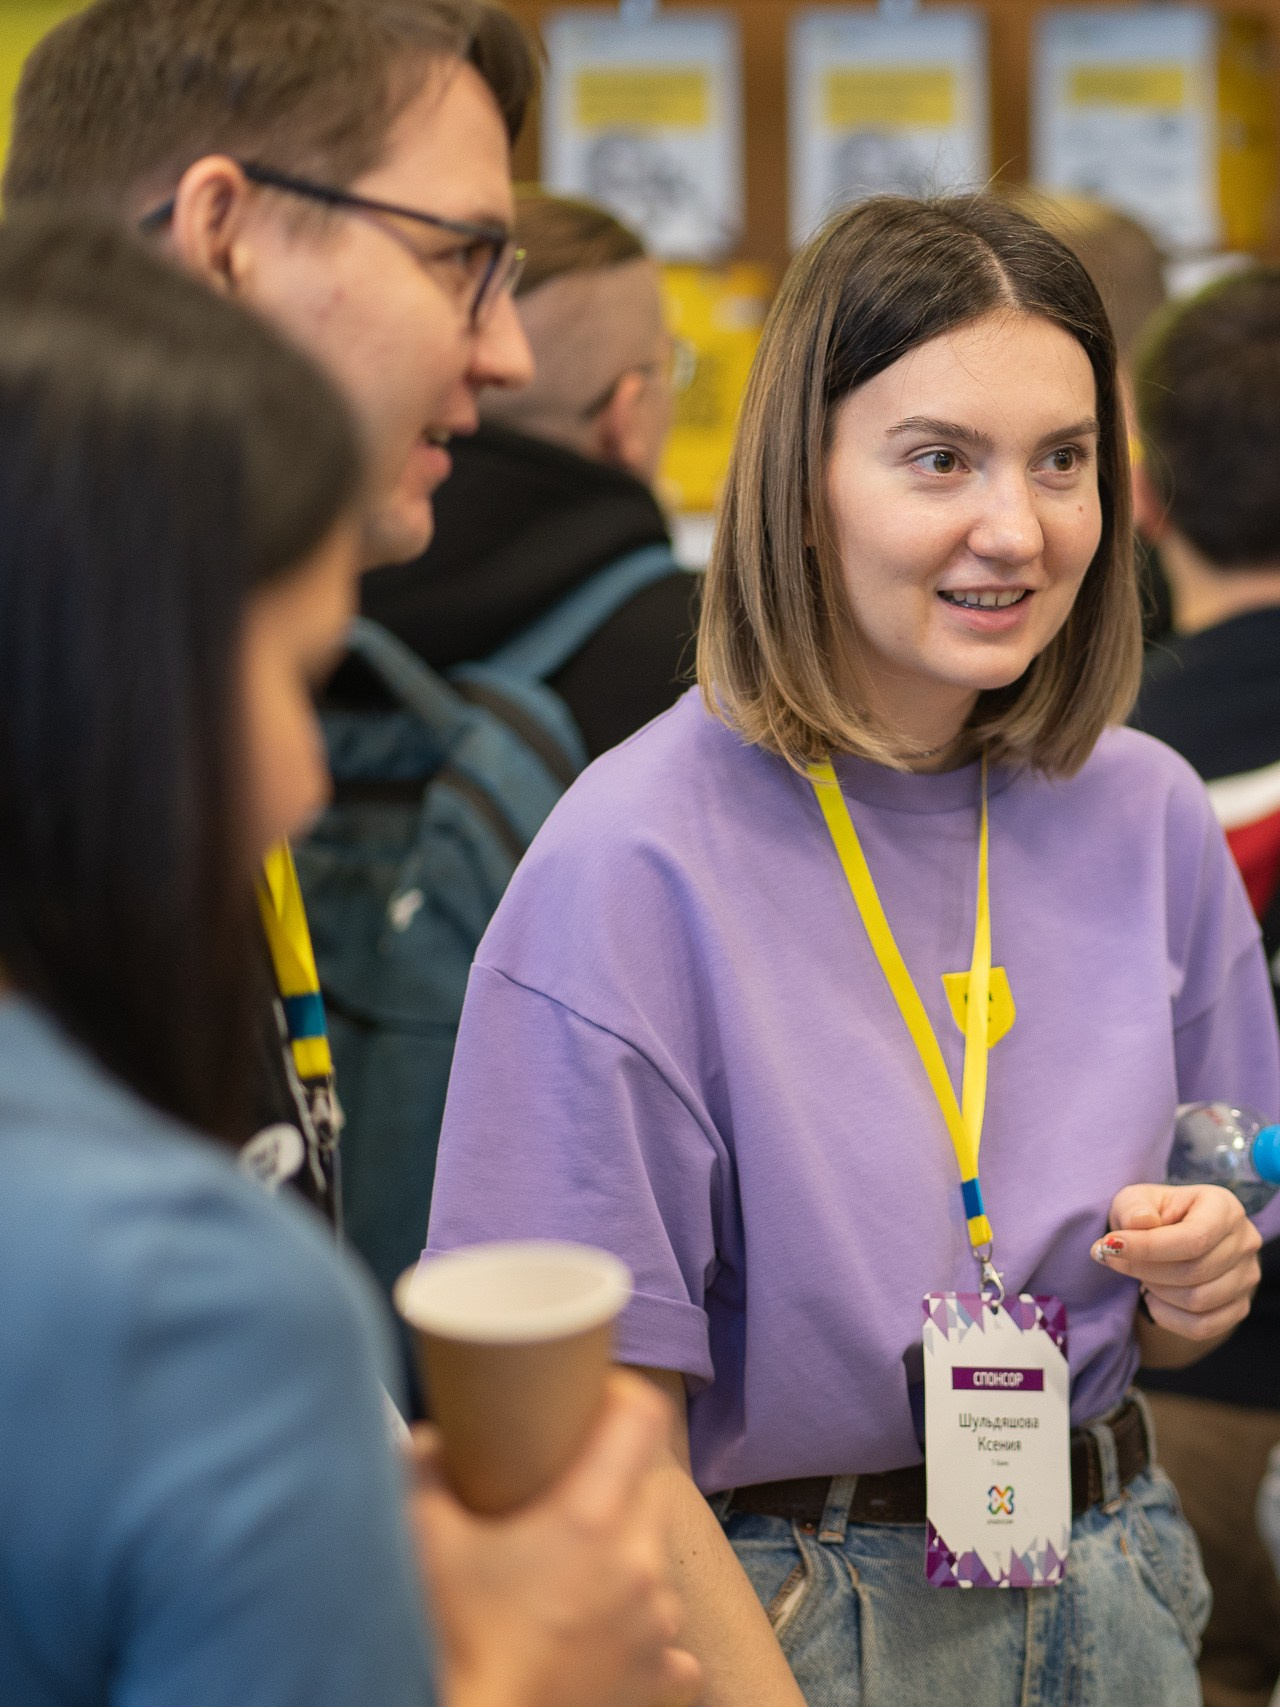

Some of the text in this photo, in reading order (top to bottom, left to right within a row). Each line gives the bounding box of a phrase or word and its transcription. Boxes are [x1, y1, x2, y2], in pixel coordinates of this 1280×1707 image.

[973, 1371, 1024, 1387] СПОНСОР
[959, 1413, 1039, 1432] Шульдяшова
[977, 1436, 1022, 1452] Ксения
